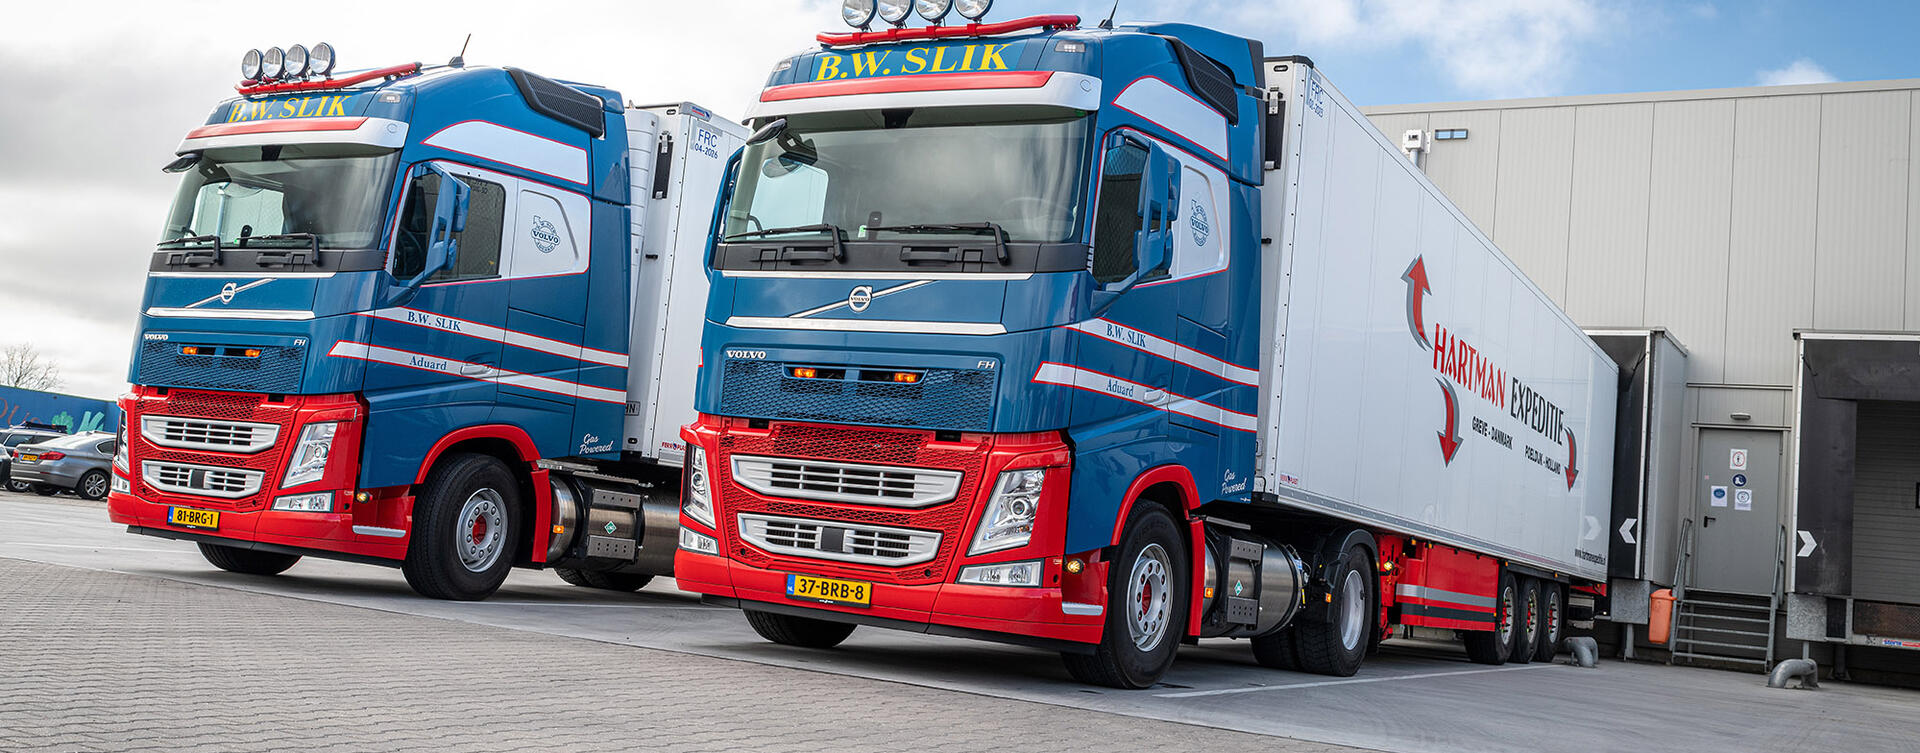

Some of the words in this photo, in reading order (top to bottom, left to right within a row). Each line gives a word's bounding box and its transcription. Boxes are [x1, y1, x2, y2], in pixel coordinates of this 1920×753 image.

[836, 49, 893, 82] B.W.
[900, 43, 1013, 74] SLIK
[227, 99, 278, 124] B.W.
[279, 95, 353, 118] SLIK
[698, 128, 718, 148] FRC
[694, 143, 719, 159] 04-2026
[532, 230, 560, 244] VOLVO
[407, 311, 431, 326] B.W.
[434, 316, 461, 331] SLIK
[143, 333, 169, 341] VOLVO
[293, 339, 306, 347] FH
[1106, 323, 1125, 341] B.W.
[1127, 330, 1146, 348] SLIK
[409, 355, 448, 371] Aduard
[725, 350, 767, 360] VOLVO
[976, 360, 996, 370] FH
[1105, 379, 1134, 398] Aduard
[1433, 322, 1507, 411] HARTMAN
[1510, 377, 1565, 446] EXPEDITIE
[583, 433, 600, 445] Gas
[1471, 416, 1488, 438] GREVE
[1491, 426, 1514, 451] DANMARK
[579, 440, 614, 455] Powered
[1545, 455, 1562, 475] HOLLAND
[1224, 468, 1236, 482] Gas
[1221, 477, 1248, 496] Powered
[177, 509, 214, 526] 81-BRG-1
[798, 578, 864, 601] 37-BRB-8
